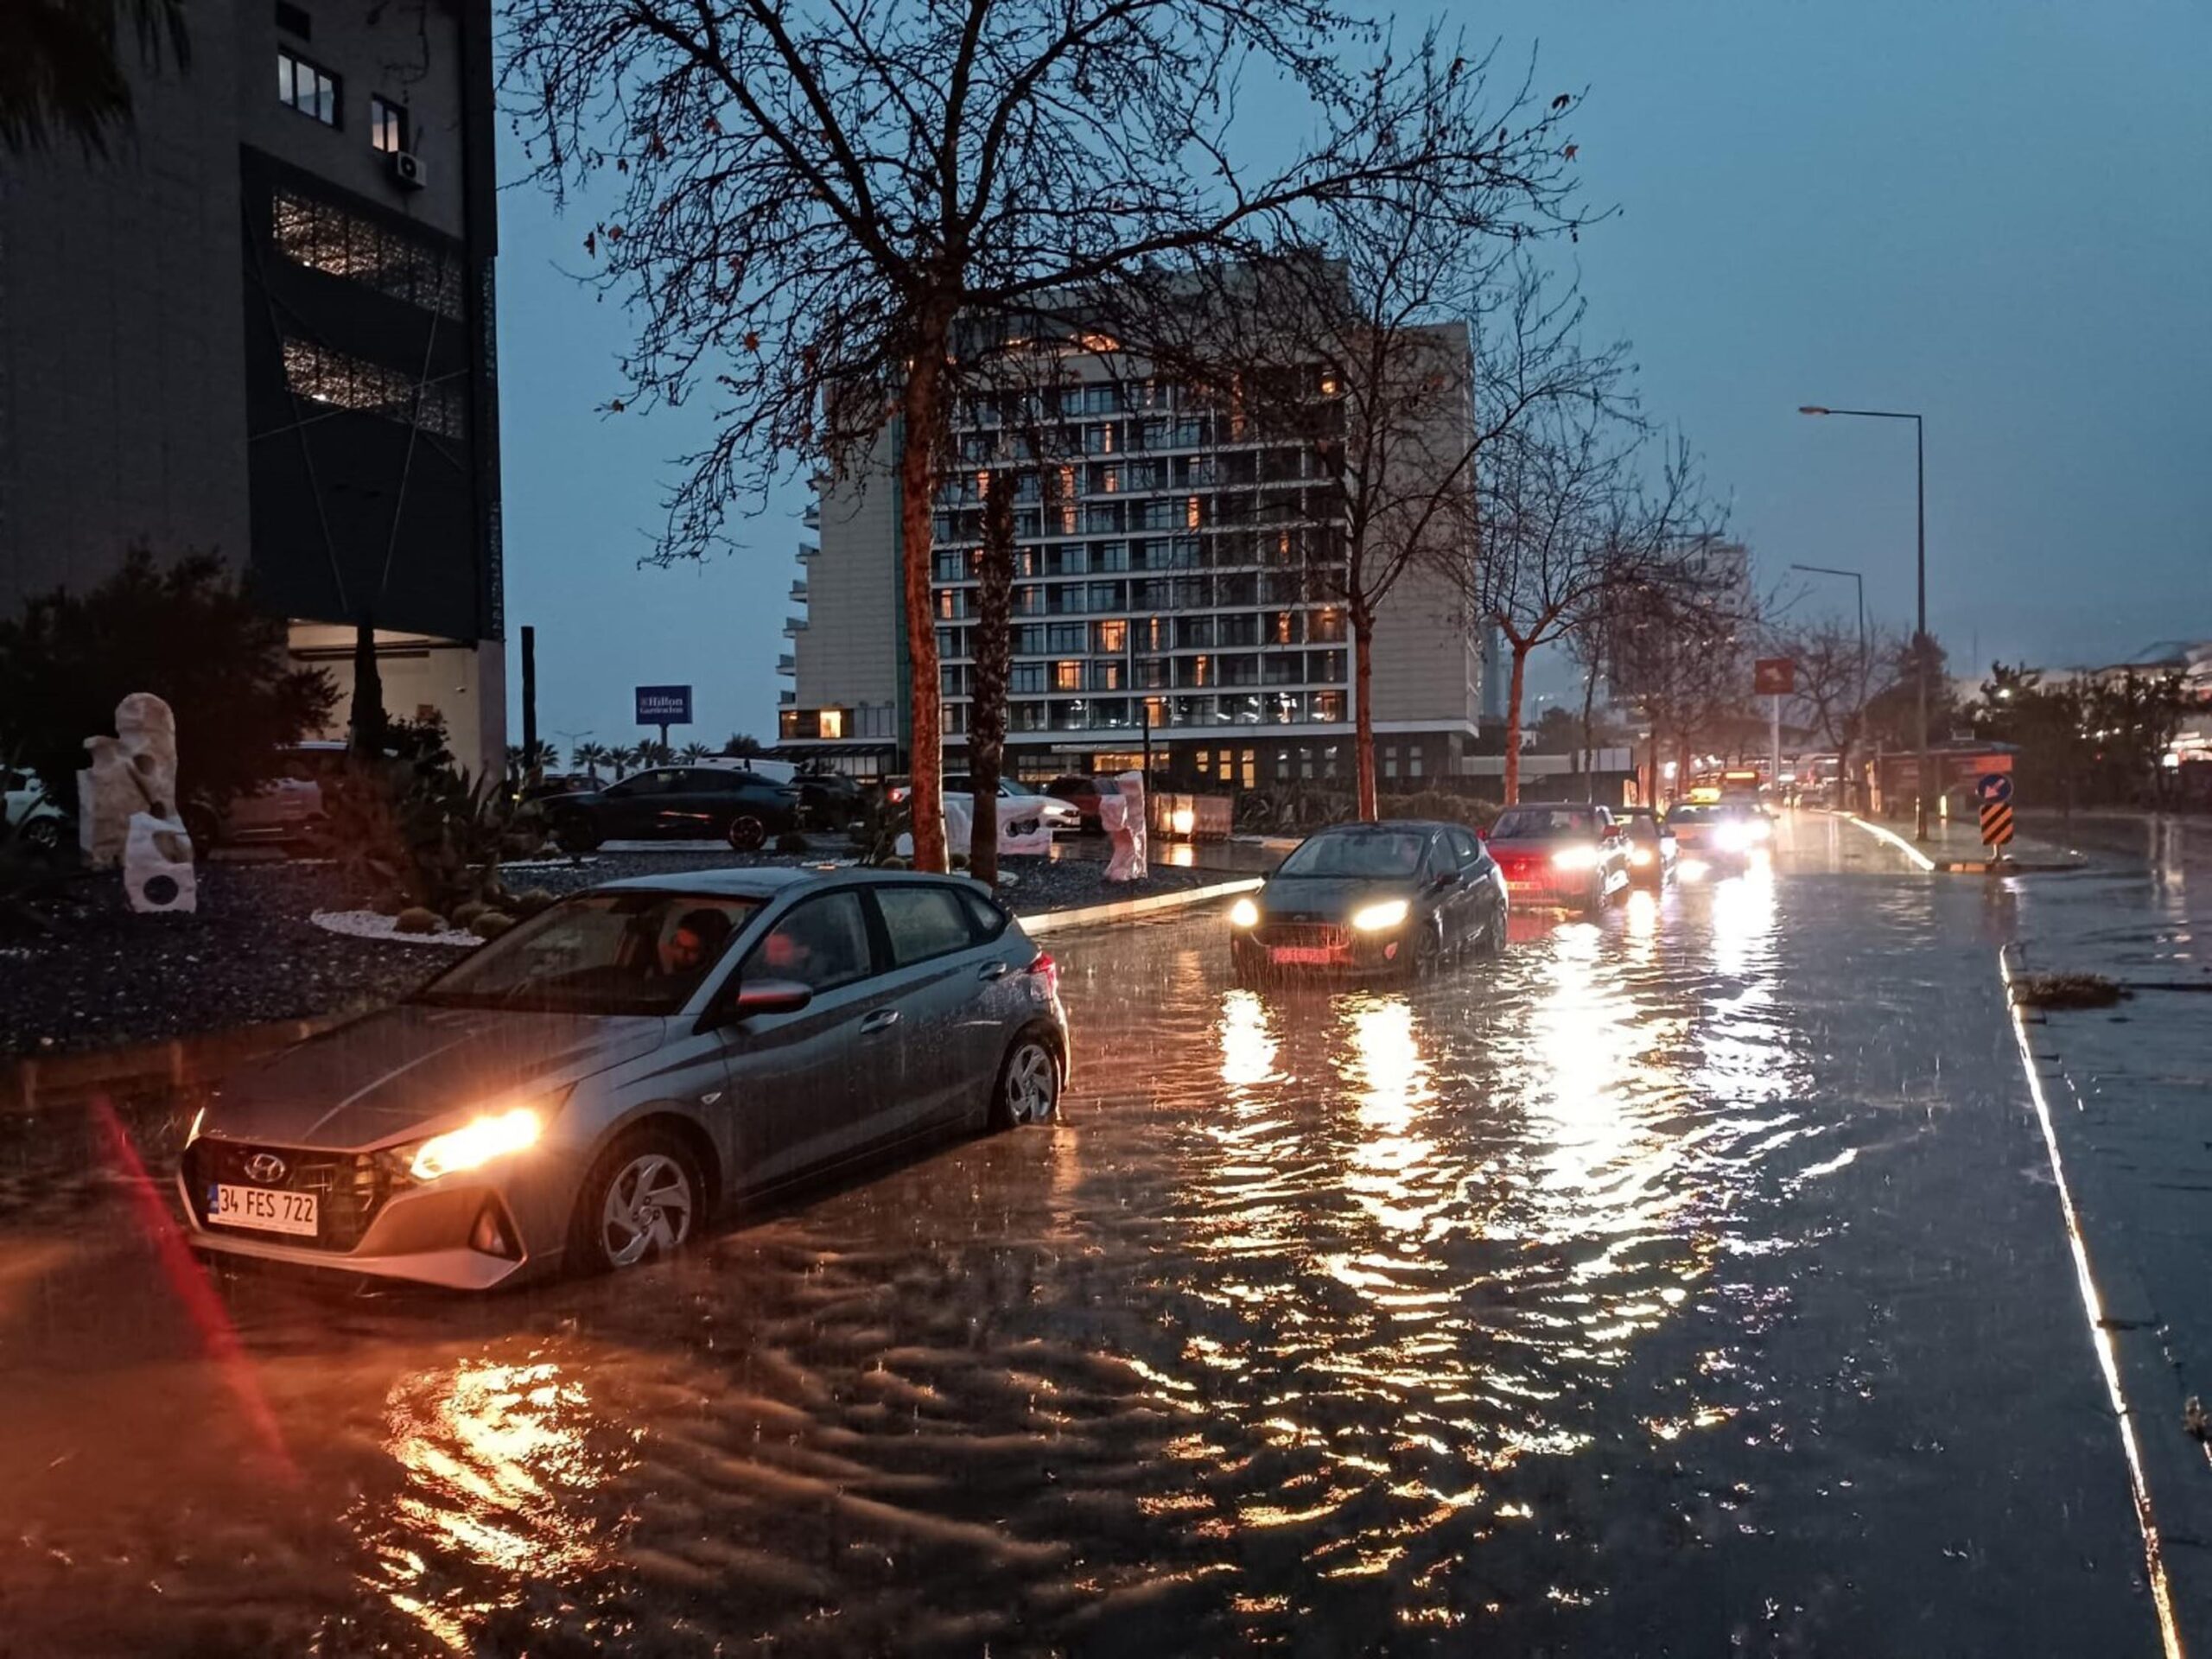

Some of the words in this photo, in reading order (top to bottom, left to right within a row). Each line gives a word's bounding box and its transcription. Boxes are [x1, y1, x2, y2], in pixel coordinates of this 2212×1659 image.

[649, 696, 683, 706] Hilton
[220, 1188, 238, 1213] 34
[247, 1191, 276, 1217] FES
[283, 1195, 313, 1222] 722
